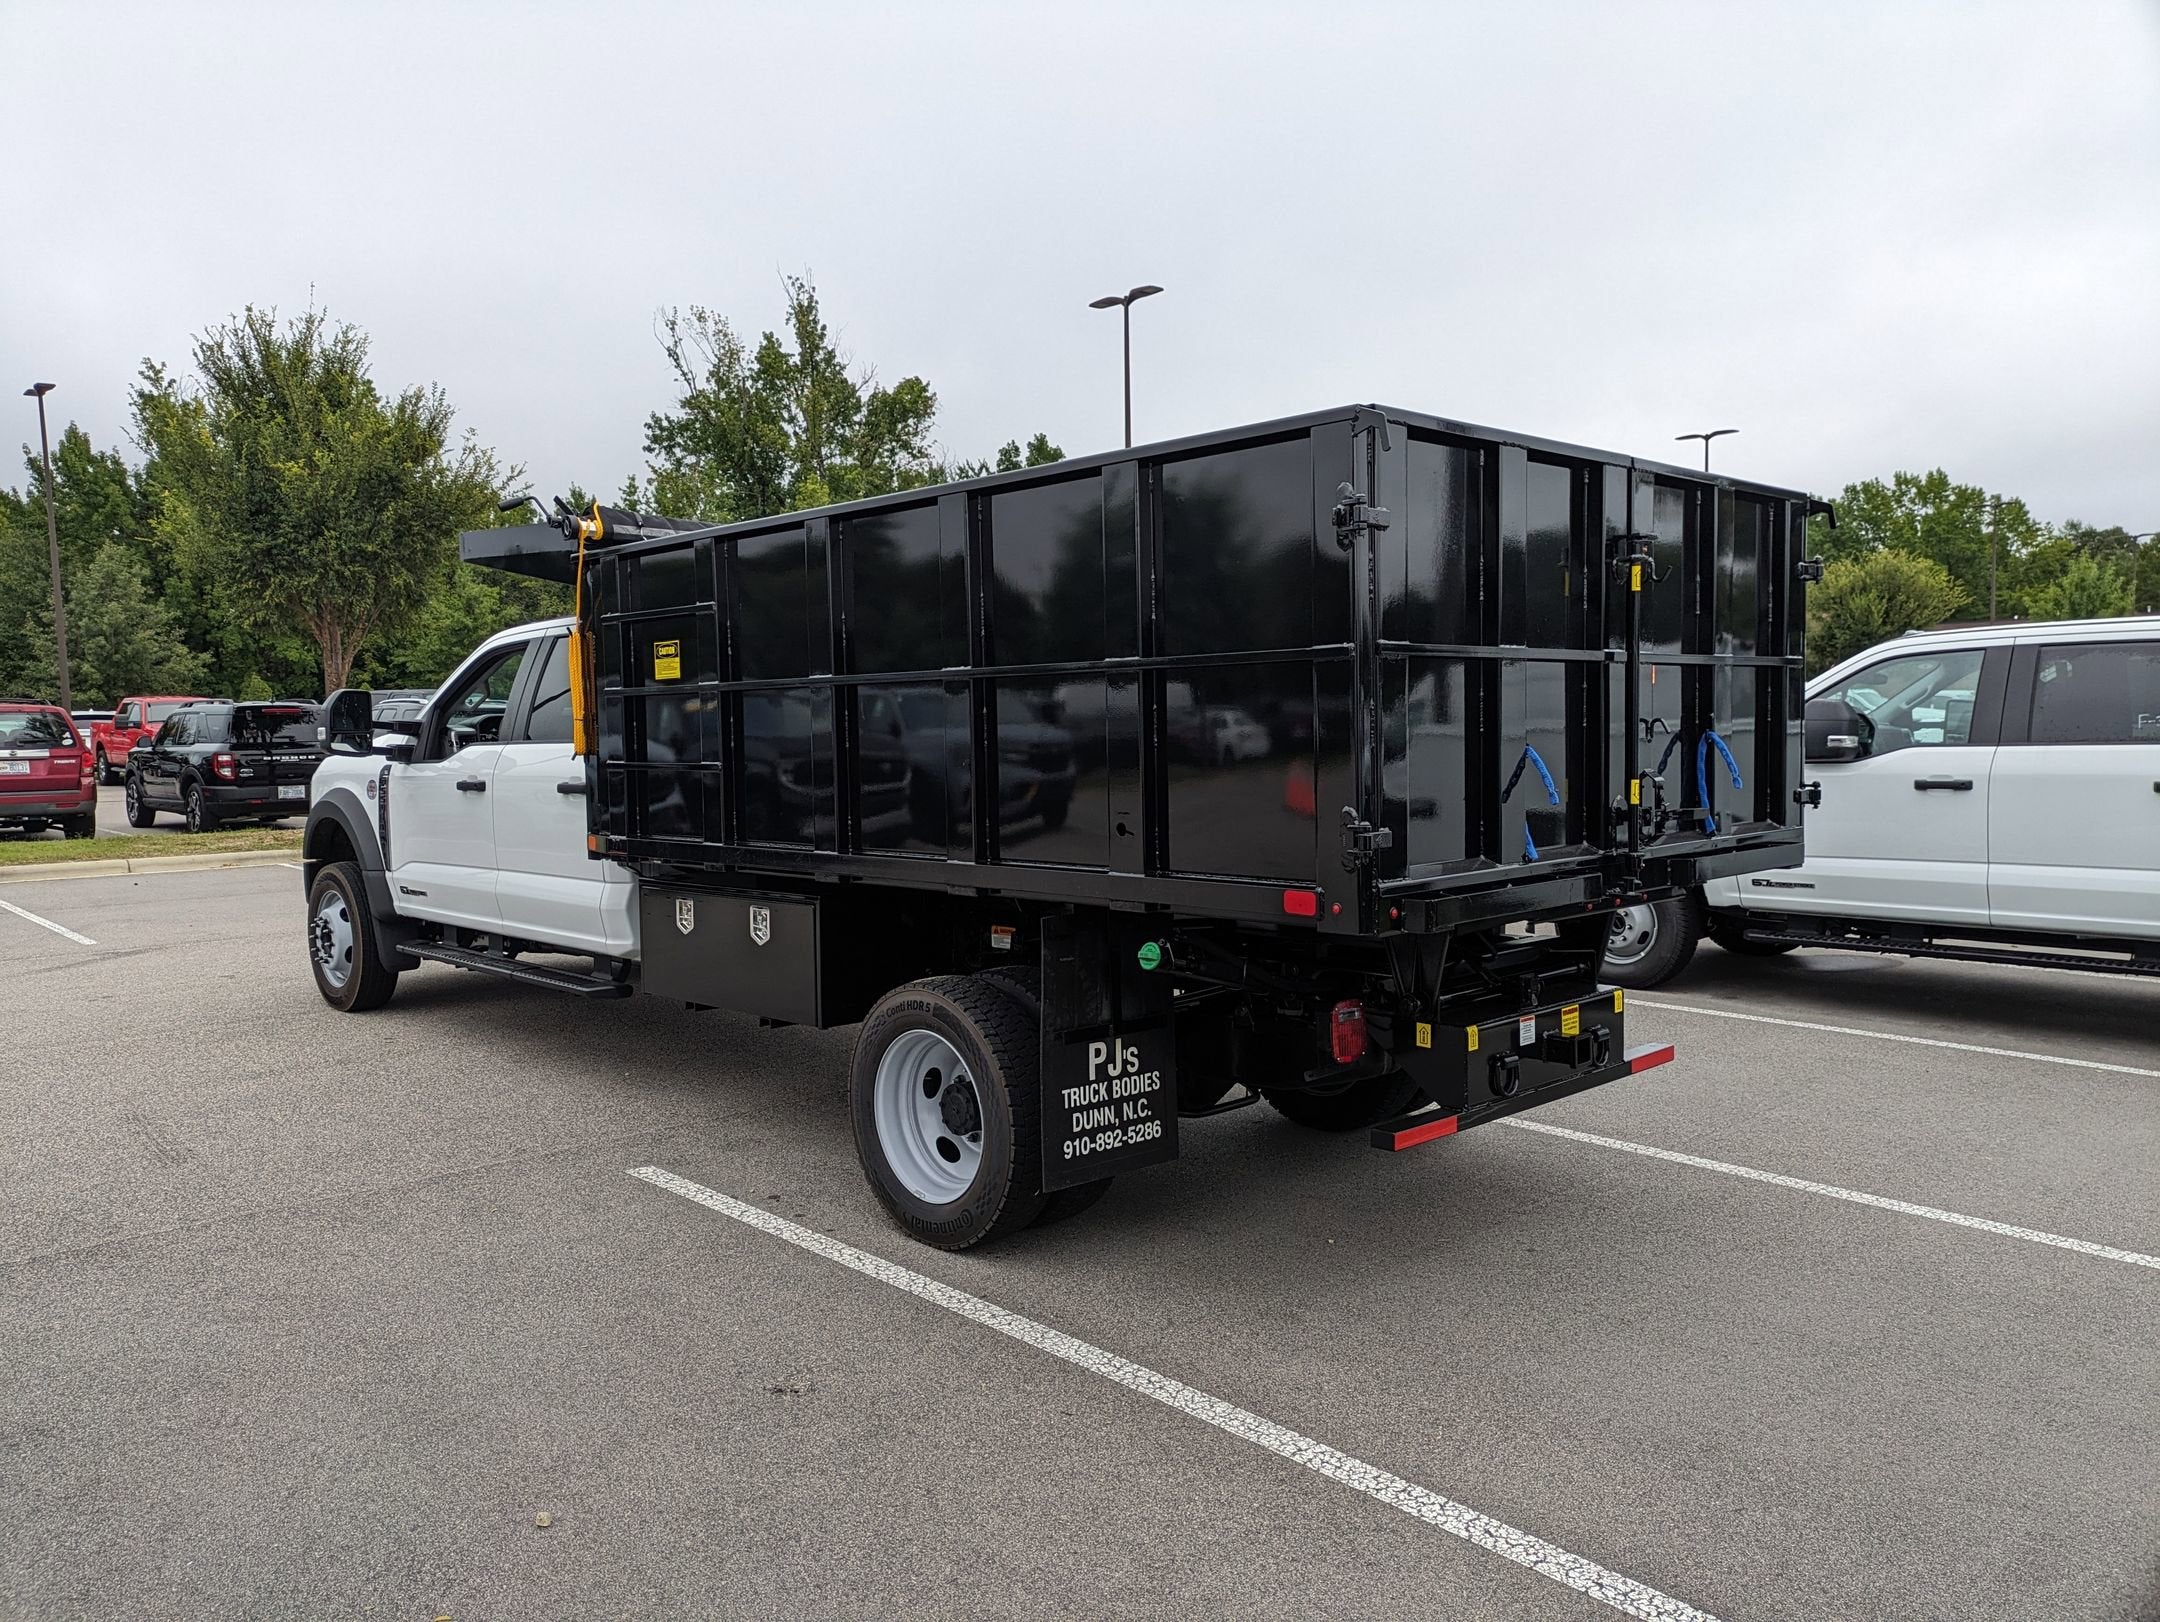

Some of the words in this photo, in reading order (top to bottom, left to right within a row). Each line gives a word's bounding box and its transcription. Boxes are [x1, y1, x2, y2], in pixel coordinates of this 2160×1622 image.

[886, 1001, 906, 1018] Conti
[906, 999, 925, 1011] HDR
[925, 1002, 932, 1013] 5
[1088, 1038, 1140, 1081] PJ's
[1061, 1081, 1109, 1109] TRUCK
[1112, 1070, 1161, 1099] BODIES
[1072, 1104, 1120, 1133] DUNN,
[1122, 1098, 1152, 1122] N.C.
[1063, 1120, 1162, 1160] 910-892-5286
[911, 1208, 974, 1234] Continental
